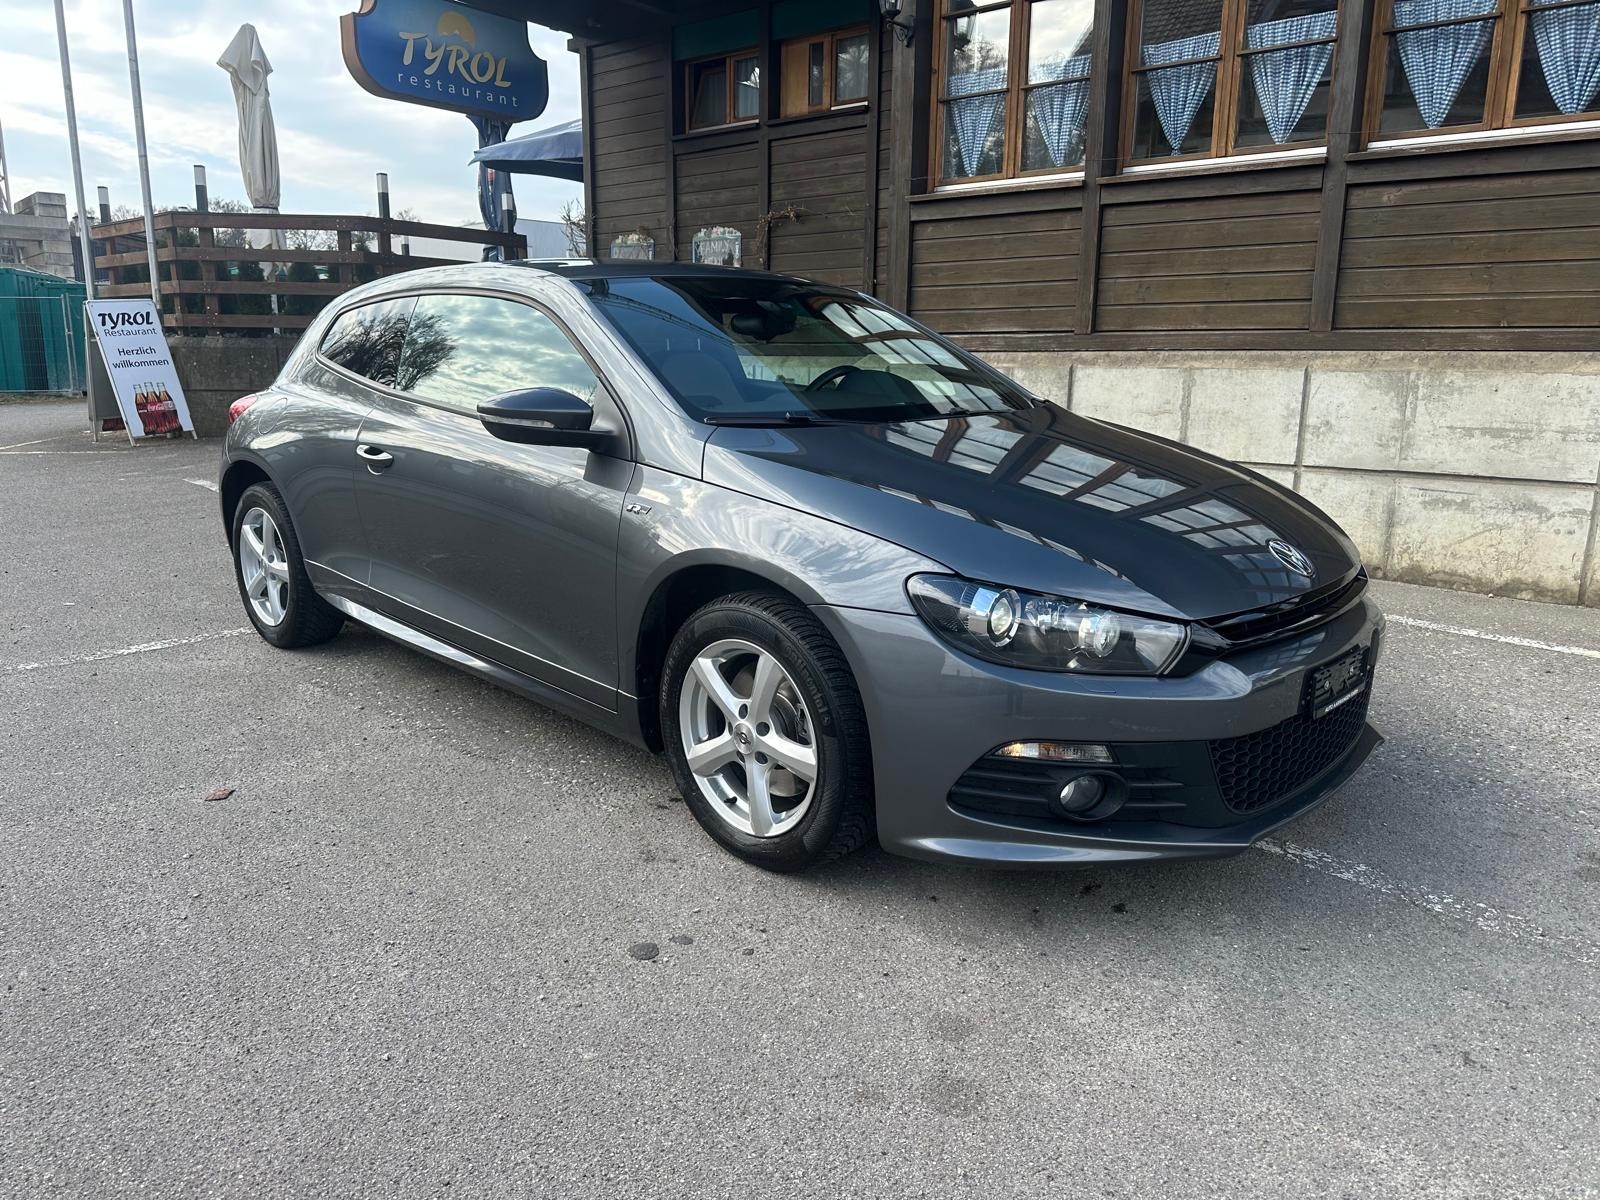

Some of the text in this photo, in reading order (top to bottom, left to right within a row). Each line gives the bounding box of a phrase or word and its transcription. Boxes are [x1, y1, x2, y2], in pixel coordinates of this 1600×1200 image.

[399, 31, 512, 88] TYROL
[398, 72, 518, 107] restaurant
[98, 311, 154, 329] TYROL
[104, 327, 157, 337] Restaurant
[118, 346, 157, 356] Herzlich
[112, 359, 169, 369] willkommen
